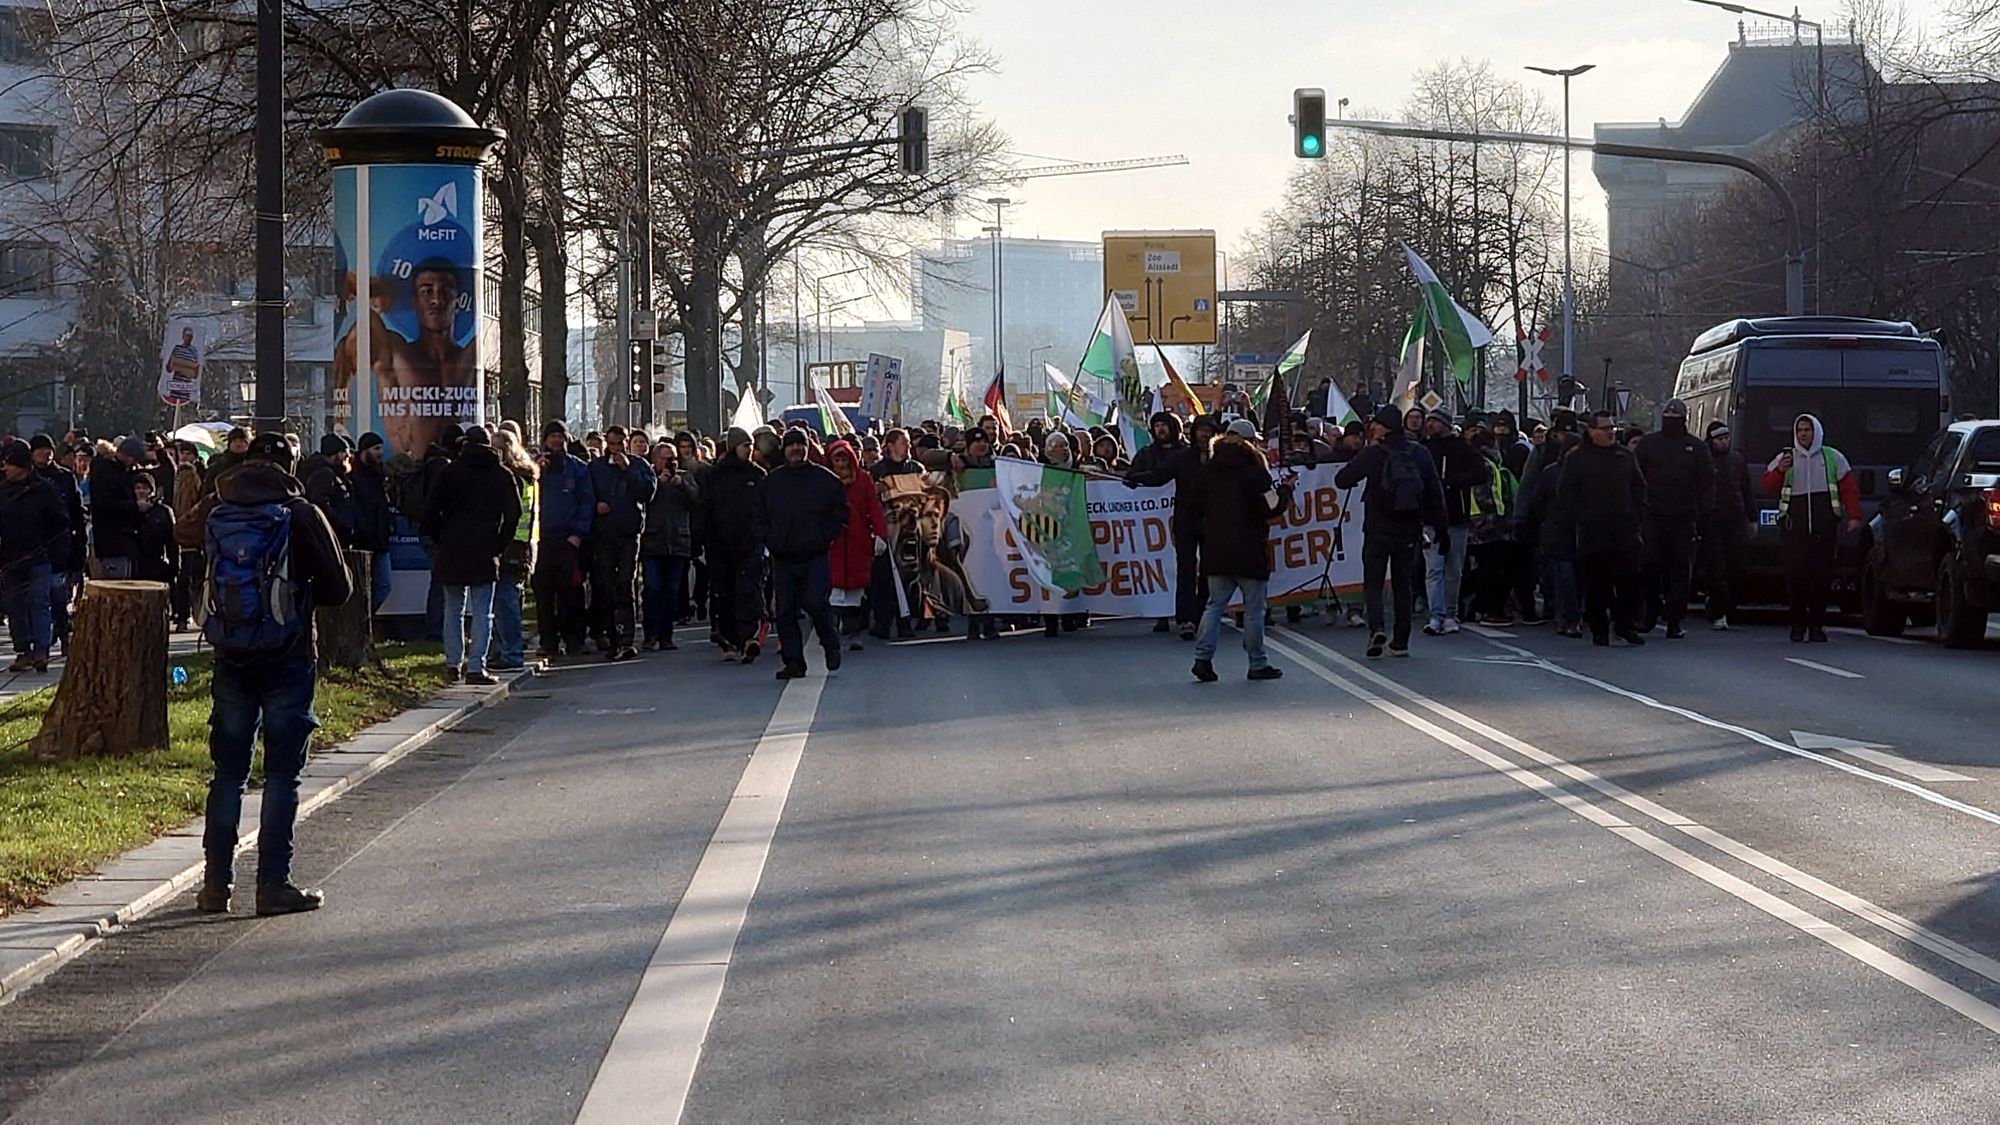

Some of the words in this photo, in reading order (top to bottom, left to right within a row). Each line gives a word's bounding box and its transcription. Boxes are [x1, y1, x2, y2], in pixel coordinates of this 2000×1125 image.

[418, 229, 457, 241] McFIT
[1147, 253, 1161, 262] Zoo
[392, 258, 412, 279] 10
[1147, 263, 1178, 271] Altstadt
[383, 386, 478, 400] MUCKI-ZUCK
[378, 403, 406, 416] INS
[410, 403, 452, 416] NEUE
[454, 403, 478, 417] JAH
[1087, 501, 1108, 514] ECK,
[1108, 501, 1133, 513] LINDNER
[1134, 501, 1140, 512] &
[1141, 499, 1159, 512] CO.
[1009, 558, 1169, 603] SUERN
[1265, 527, 1345, 573] TER!
